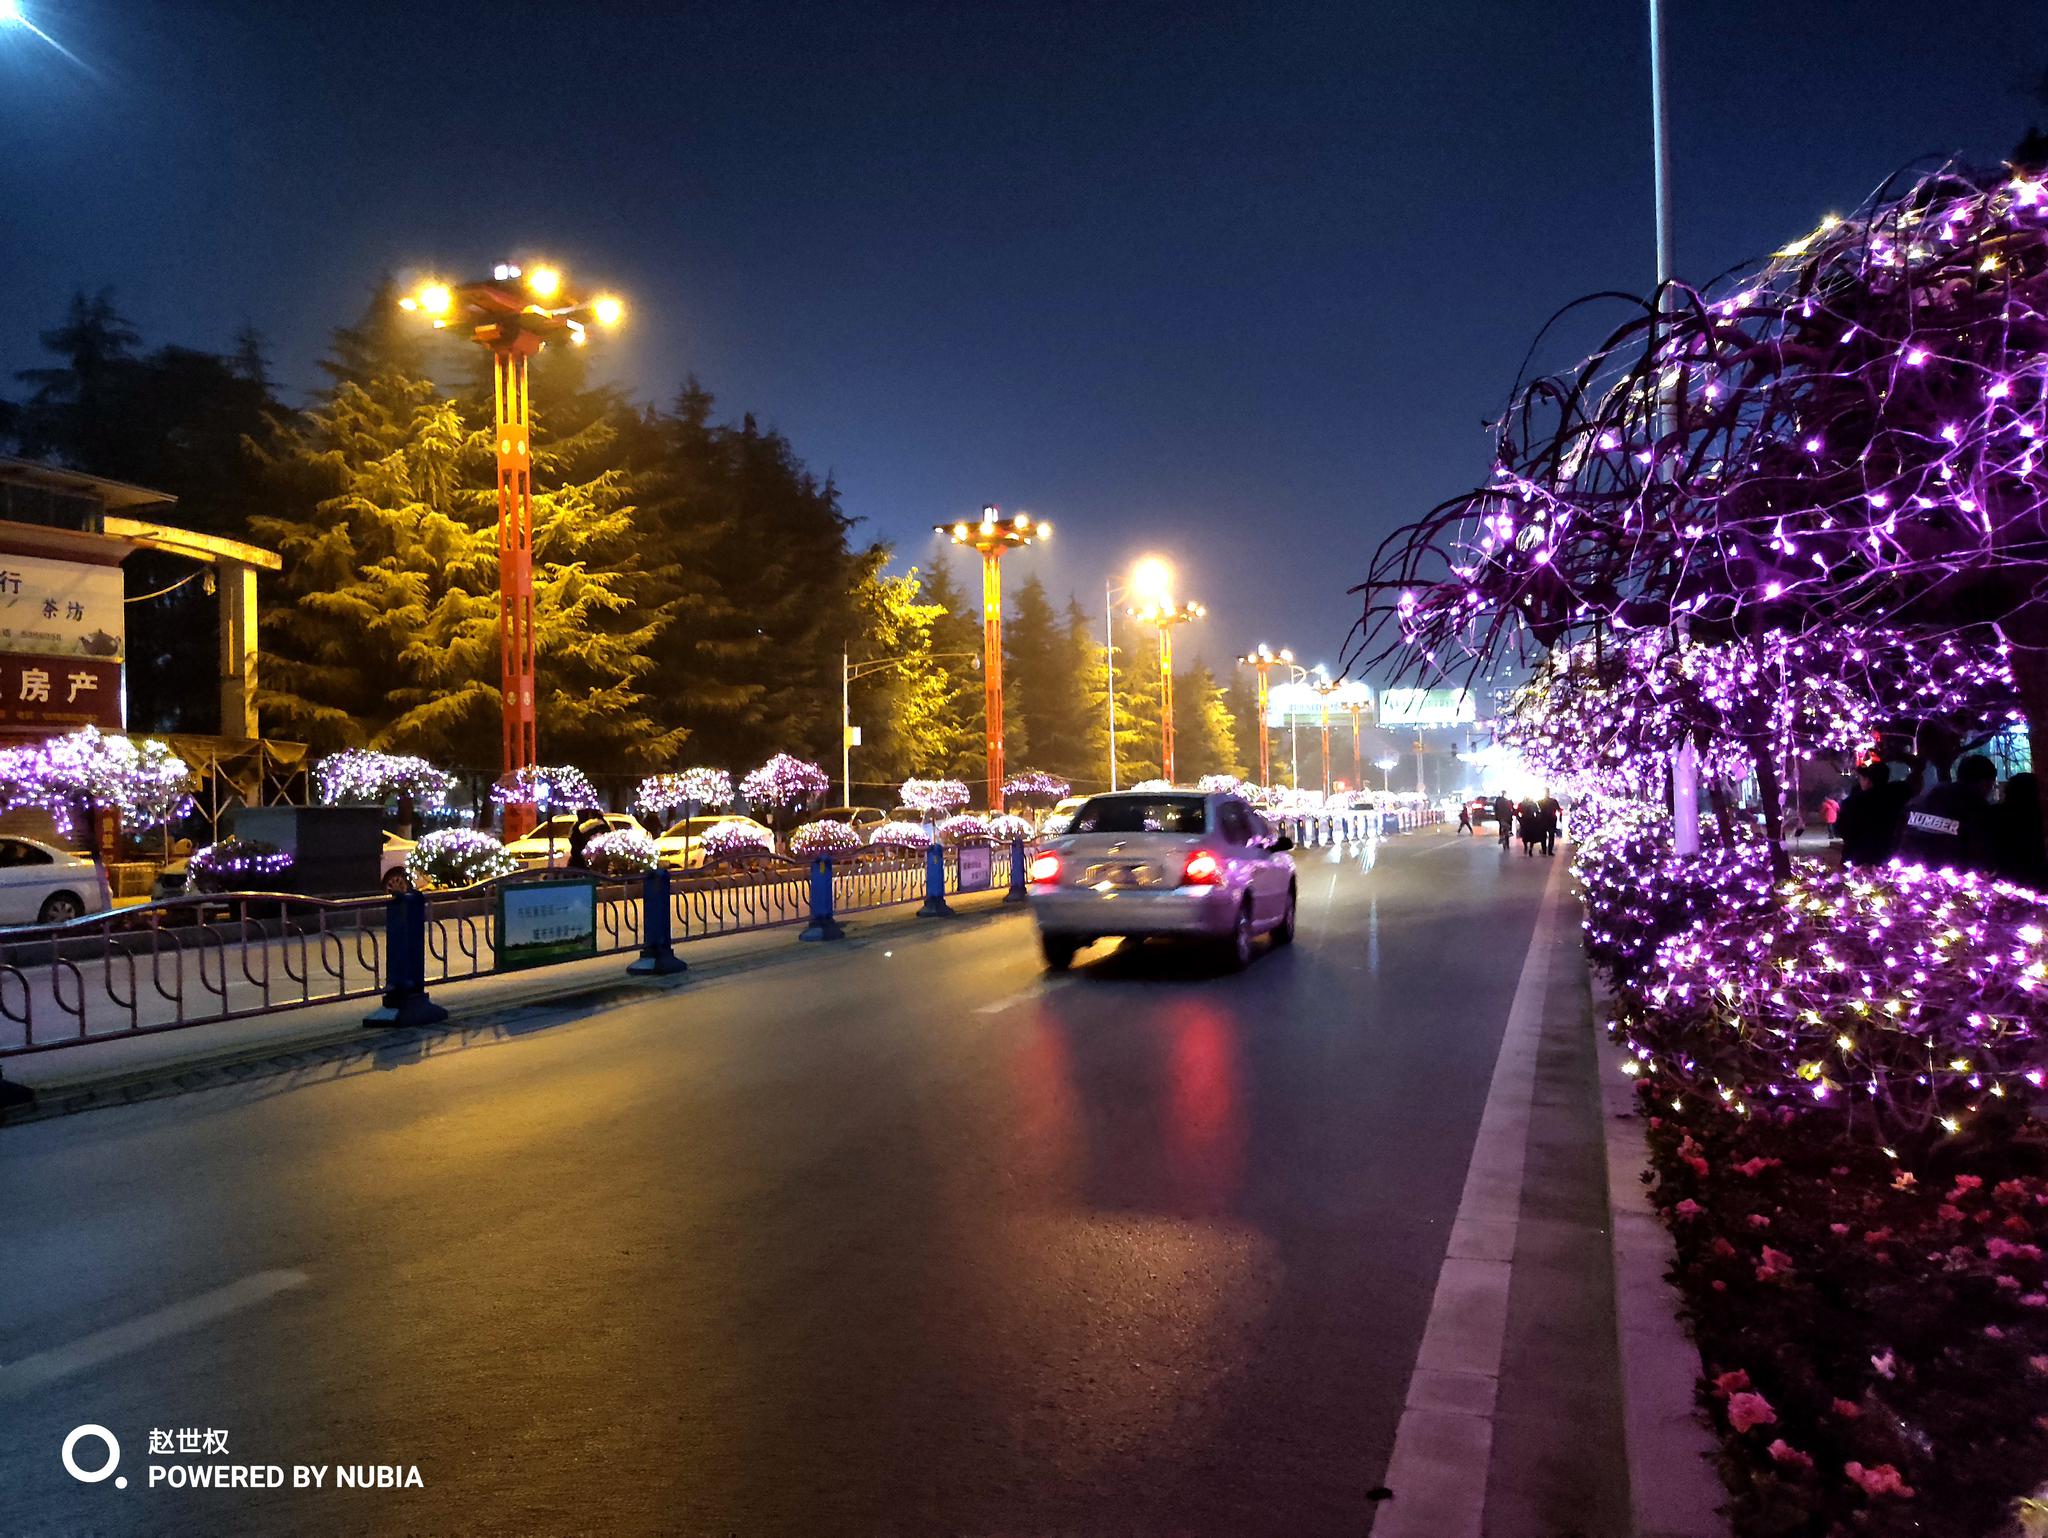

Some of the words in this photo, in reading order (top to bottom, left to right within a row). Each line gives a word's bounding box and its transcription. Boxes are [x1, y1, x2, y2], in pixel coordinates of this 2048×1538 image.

[0, 570, 22, 594] 行
[42, 598, 84, 622] 茶坊
[0, 667, 98, 704] 房产
[1908, 811, 1959, 836] NUMBER
